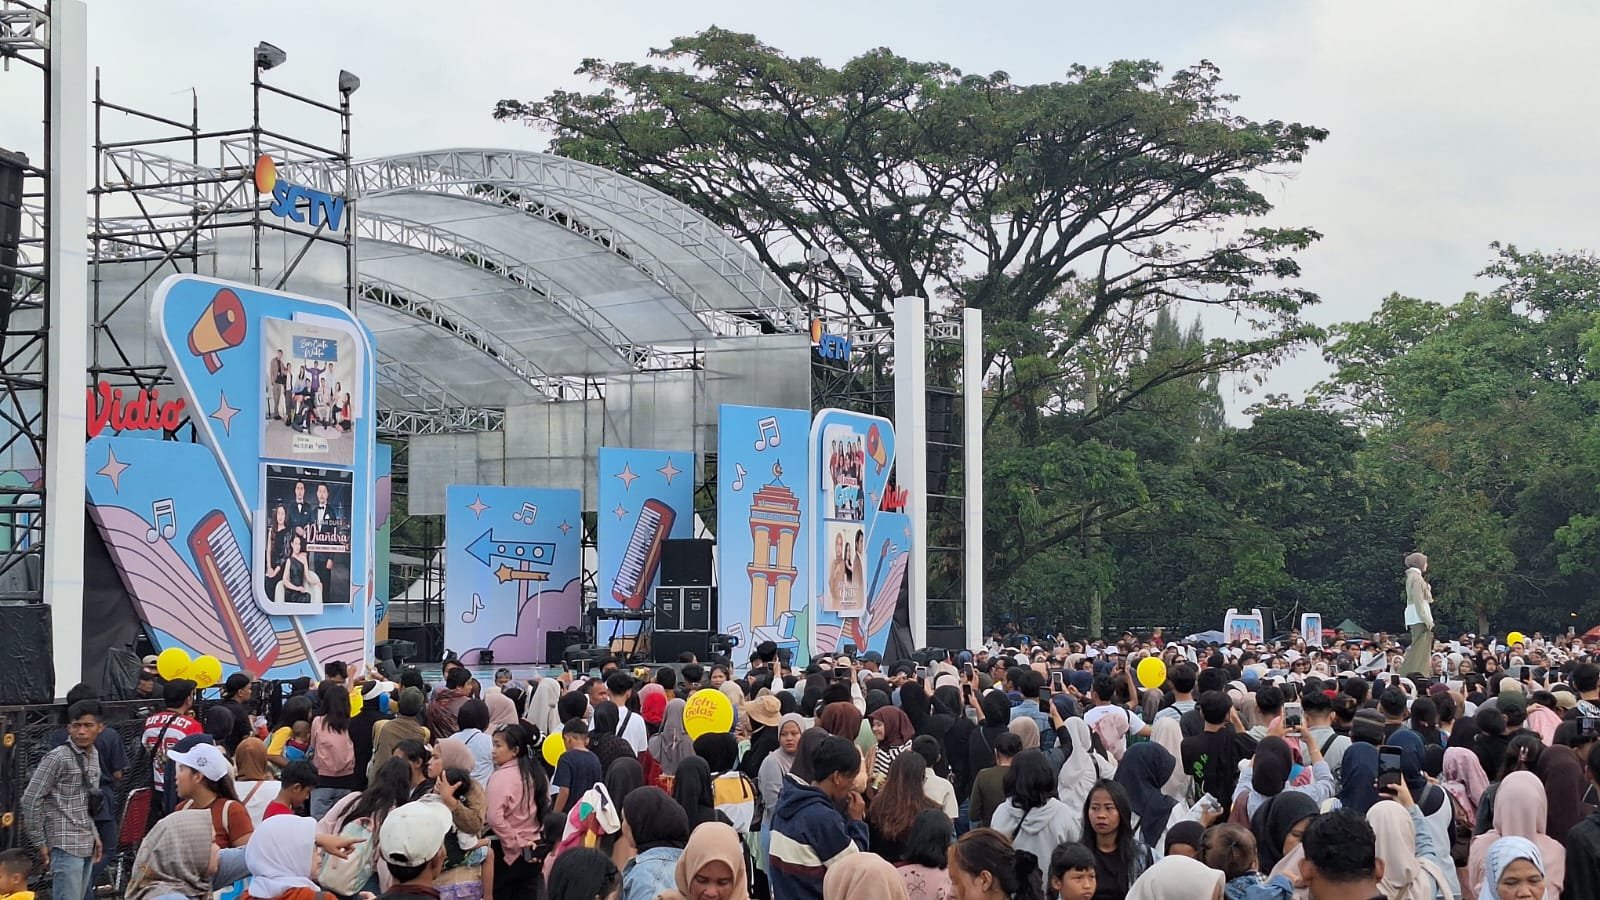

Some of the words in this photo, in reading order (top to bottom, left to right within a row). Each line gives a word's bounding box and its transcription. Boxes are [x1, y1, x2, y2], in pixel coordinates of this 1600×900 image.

[270, 179, 345, 231] SCTV
[819, 333, 852, 361] SCTV
[86, 380, 186, 438] Vidio
